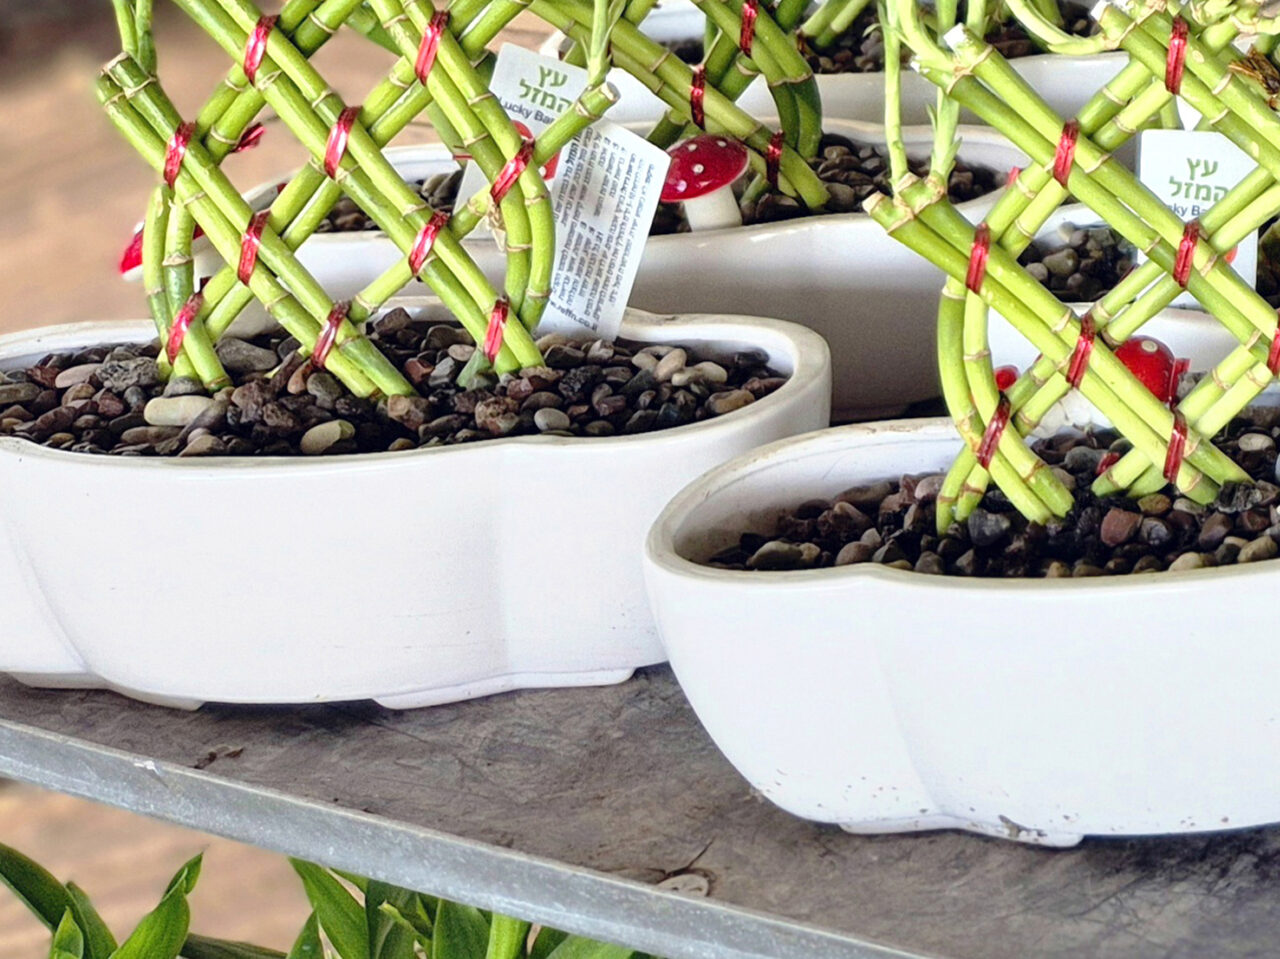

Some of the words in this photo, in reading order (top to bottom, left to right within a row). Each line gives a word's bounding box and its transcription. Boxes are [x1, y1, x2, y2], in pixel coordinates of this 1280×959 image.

[538, 65, 568, 88] עץ
[519, 78, 573, 112] המזל
[500, 97, 533, 119] ucky
[1187, 157, 1218, 180] עץ
[1169, 176, 1229, 202] המזל
